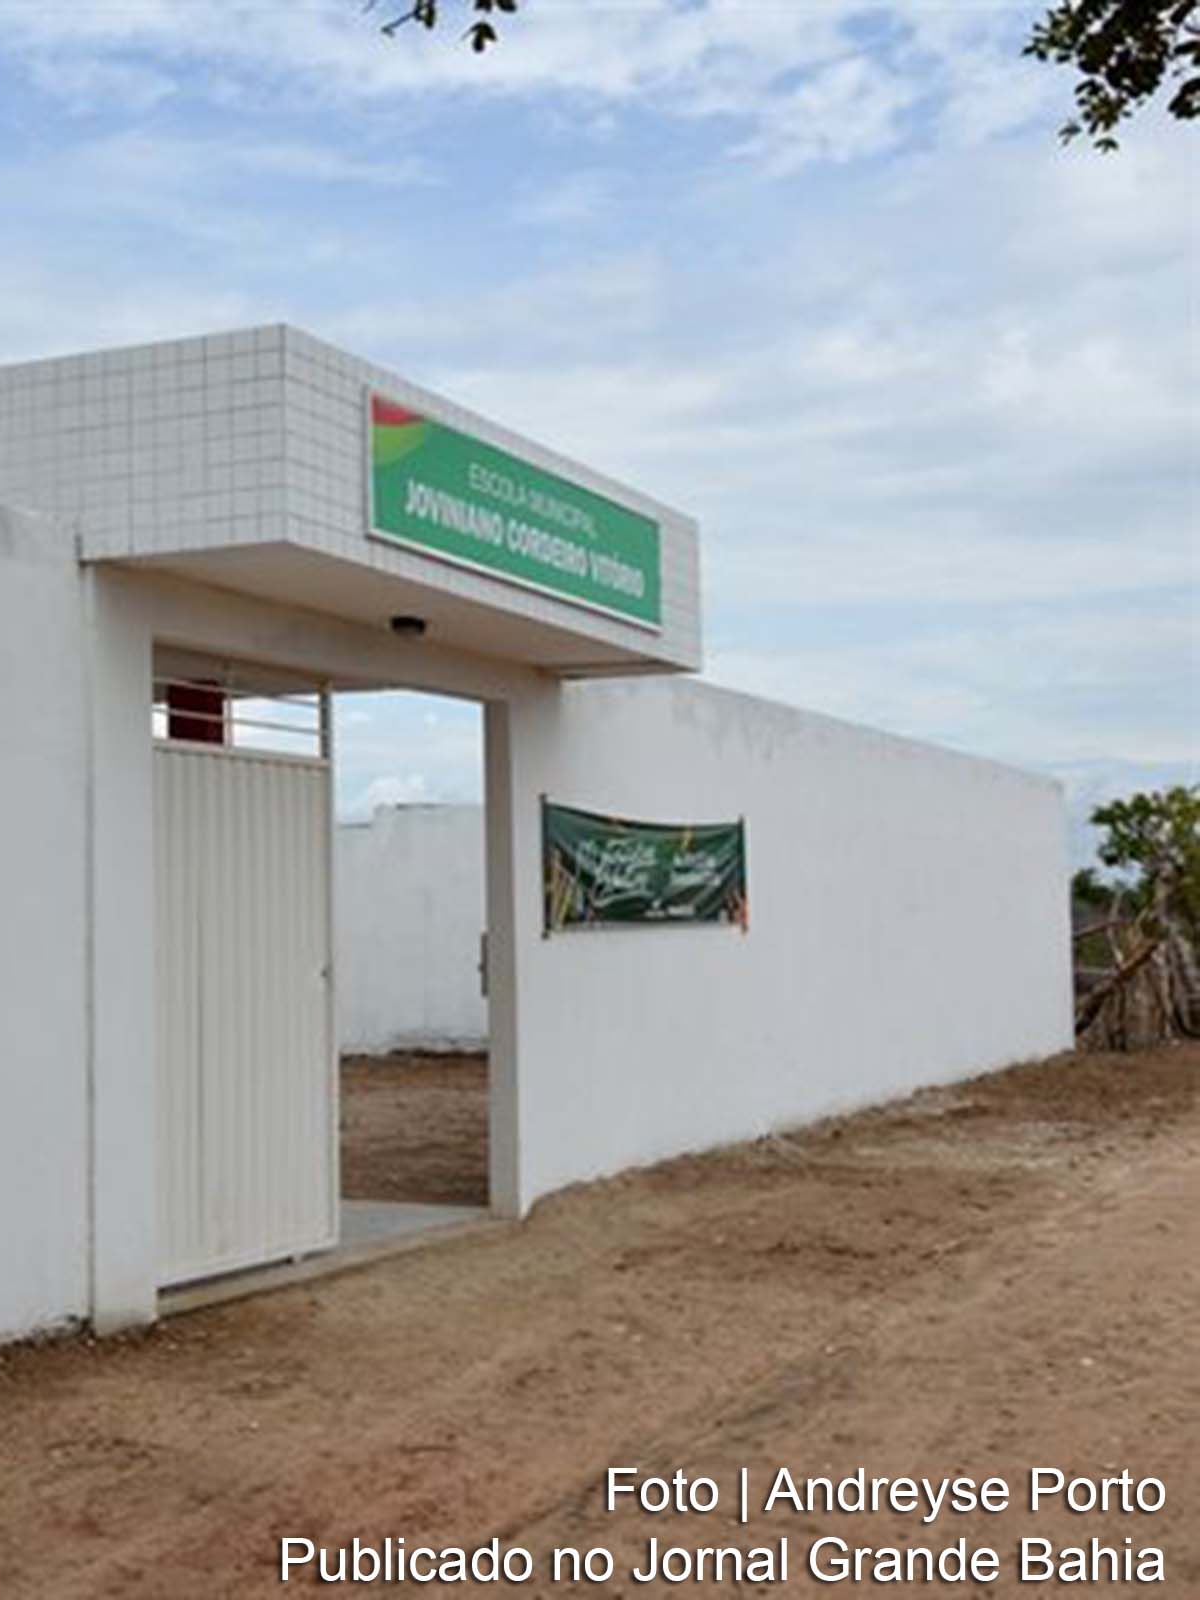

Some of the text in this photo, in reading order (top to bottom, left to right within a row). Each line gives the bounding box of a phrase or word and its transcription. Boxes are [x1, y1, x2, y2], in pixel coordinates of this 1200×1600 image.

[469, 463, 527, 504] ESCOLA
[405, 478, 502, 545] JOVINIANO
[507, 519, 587, 577] CORDEIRO
